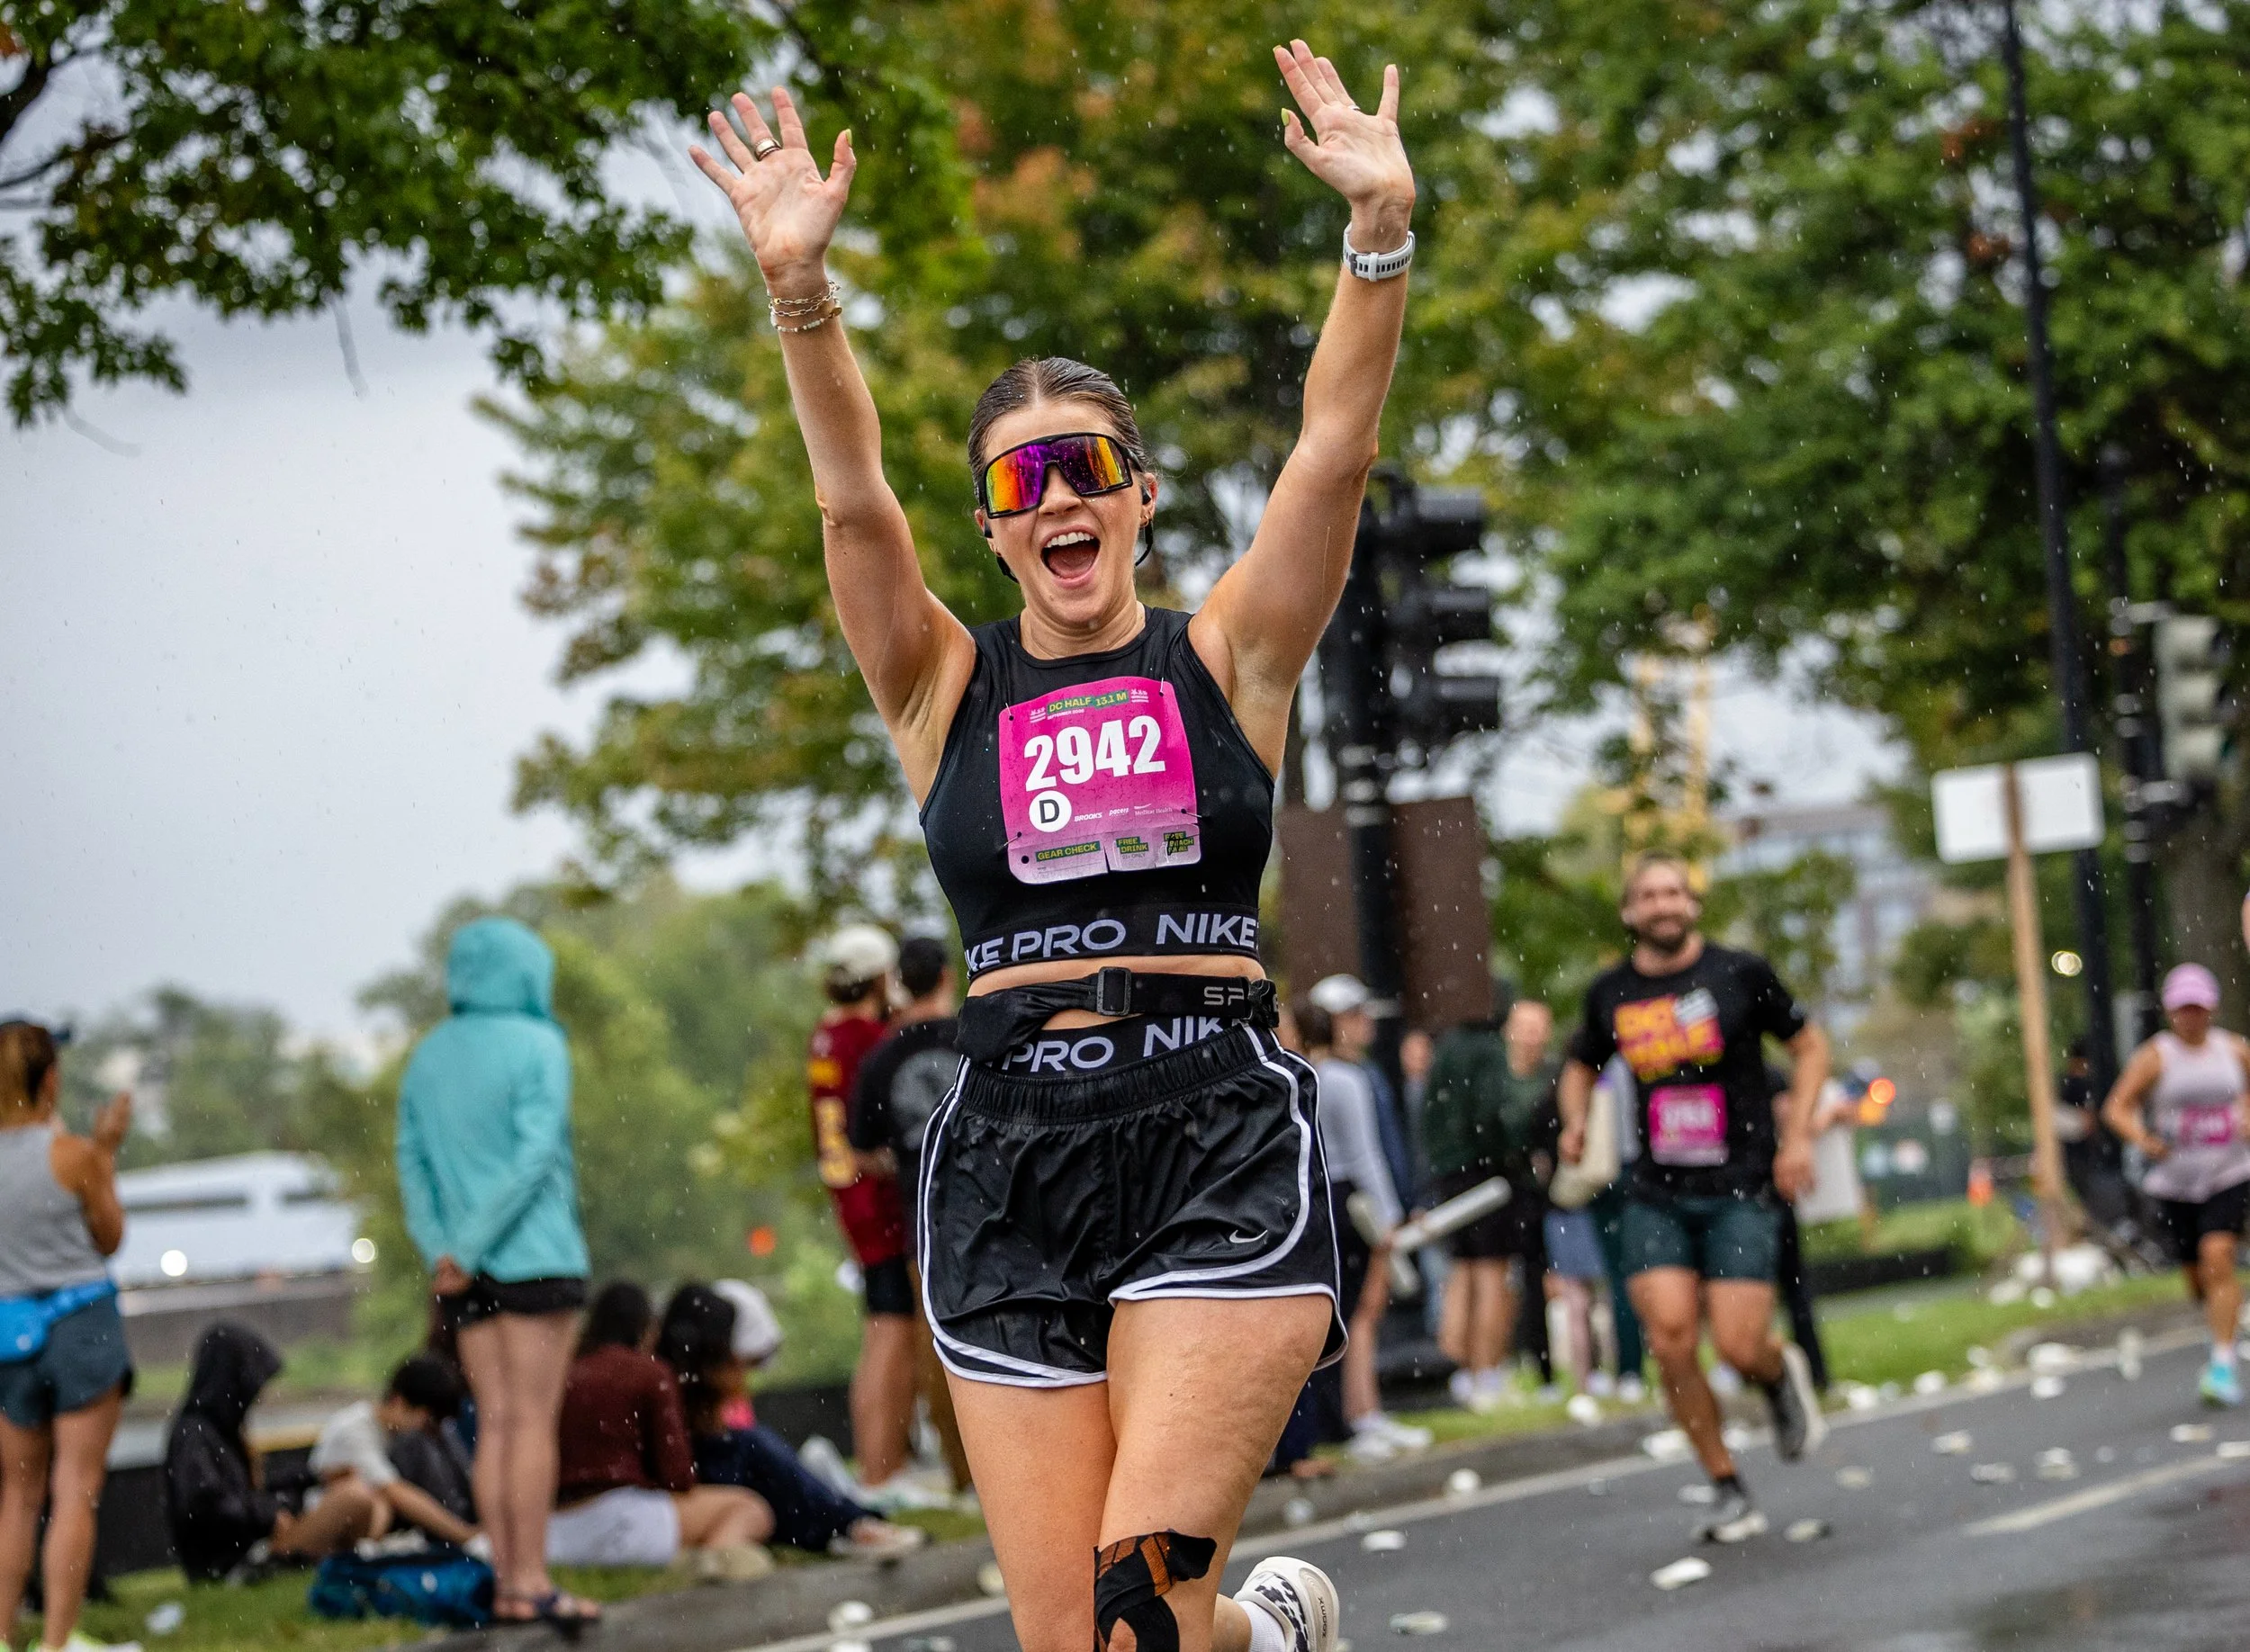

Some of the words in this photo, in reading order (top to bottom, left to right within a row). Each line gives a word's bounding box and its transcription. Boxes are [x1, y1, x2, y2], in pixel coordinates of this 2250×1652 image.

[1049, 702, 1063, 713] DC
[1065, 696, 1092, 708] HALF
[1095, 695, 1115, 706] 13.1
[1116, 692, 1127, 701] M
[1047, 710, 1072, 721] SEPTEMBER
[1022, 715, 1166, 792] 2942
[1039, 799, 1060, 823] D
[1074, 813, 1102, 822] BROOKS
[1109, 807, 1130, 816] pacers
[1038, 848, 1064, 861] GEAR
[1065, 842, 1097, 856] CHECK
[1118, 838, 1138, 847] FREE
[1121, 843, 1148, 853] DRINK
[965, 937, 1004, 973] KE
[1010, 919, 1126, 962] PRO
[1156, 912, 1257, 947] NIKE
[1002, 1036, 1114, 1073] PRO
